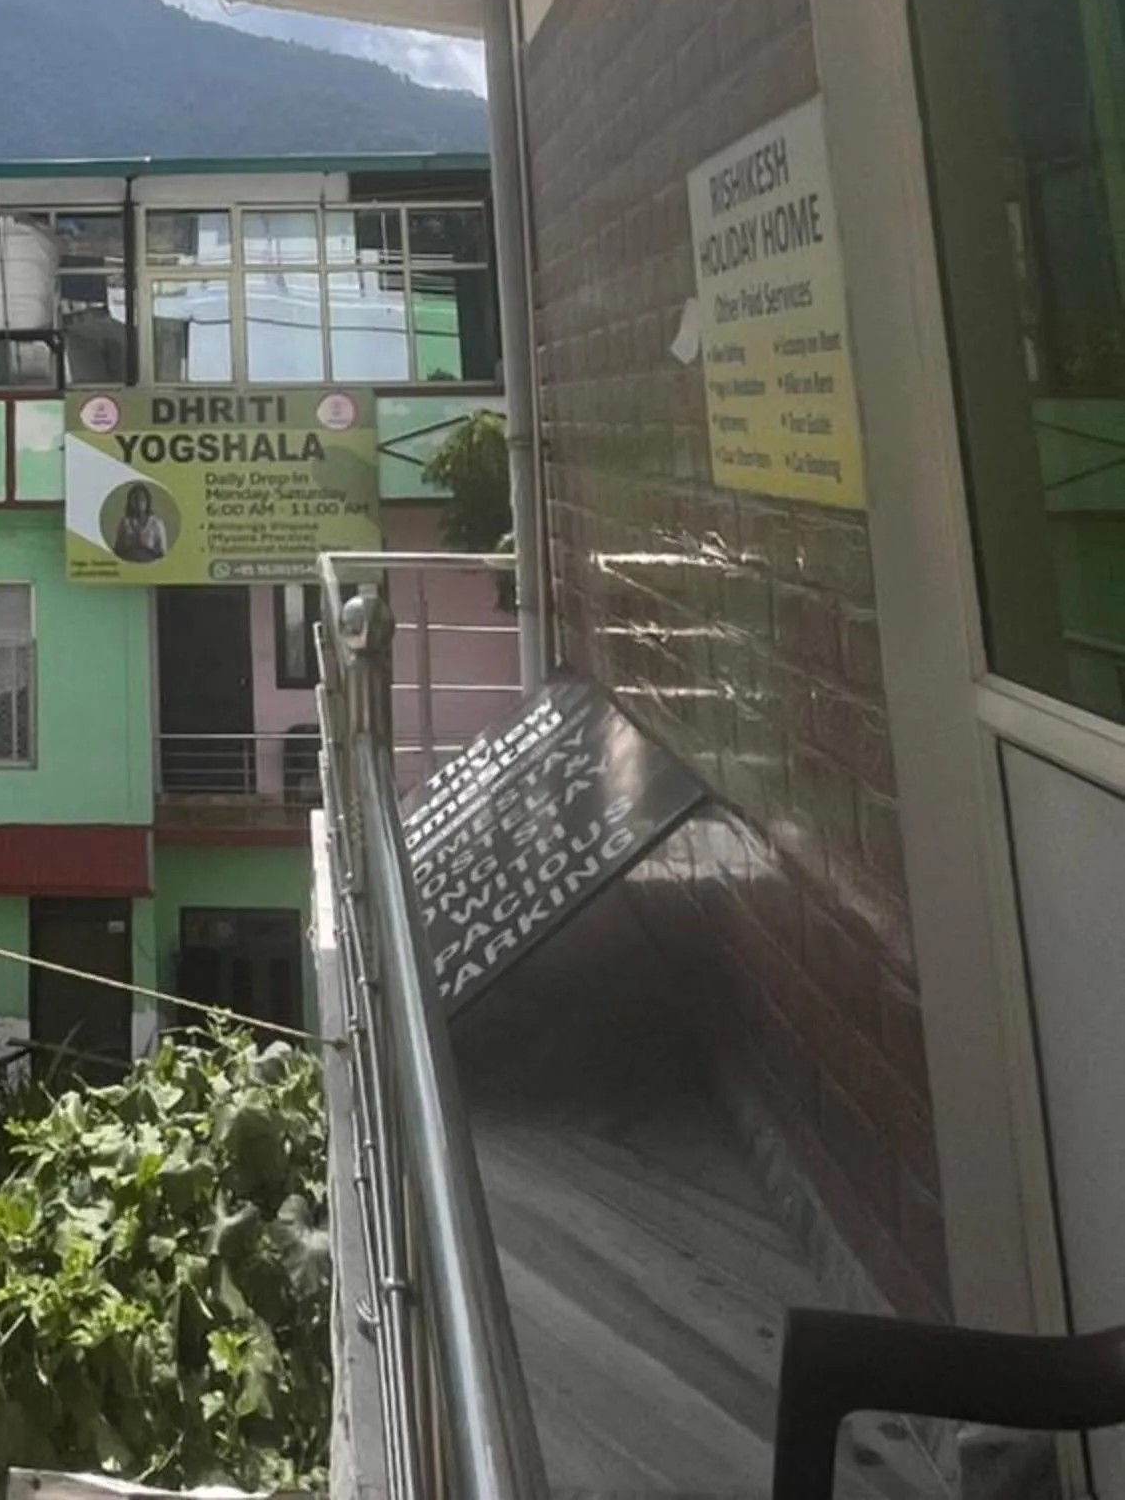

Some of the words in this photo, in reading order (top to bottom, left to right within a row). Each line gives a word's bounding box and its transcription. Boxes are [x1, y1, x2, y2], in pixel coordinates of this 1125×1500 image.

[709, 136, 789, 217] RISHIKESH
[699, 213, 759, 279] HOLIDAY
[761, 192, 823, 259] HOME
[115, 432, 327, 464] YOGSHALA
[151, 396, 288, 426] DHRITI
[205, 471, 245, 488] Daily
[206, 503, 245, 516] 6:00
[249, 503, 275, 516] AM
[291, 502, 340, 516] 11:00
[344, 501, 369, 515] AM
[405, 710, 563, 849] omeStay
[413, 727, 585, 885] OMESTAY
[427, 738, 488, 790] The
[512, 753, 610, 847] STAY
[421, 791, 551, 899] OSTEL
[433, 794, 634, 977] PACIOUS
[449, 822, 566, 925] WITH
[438, 826, 635, 997] ARKING
